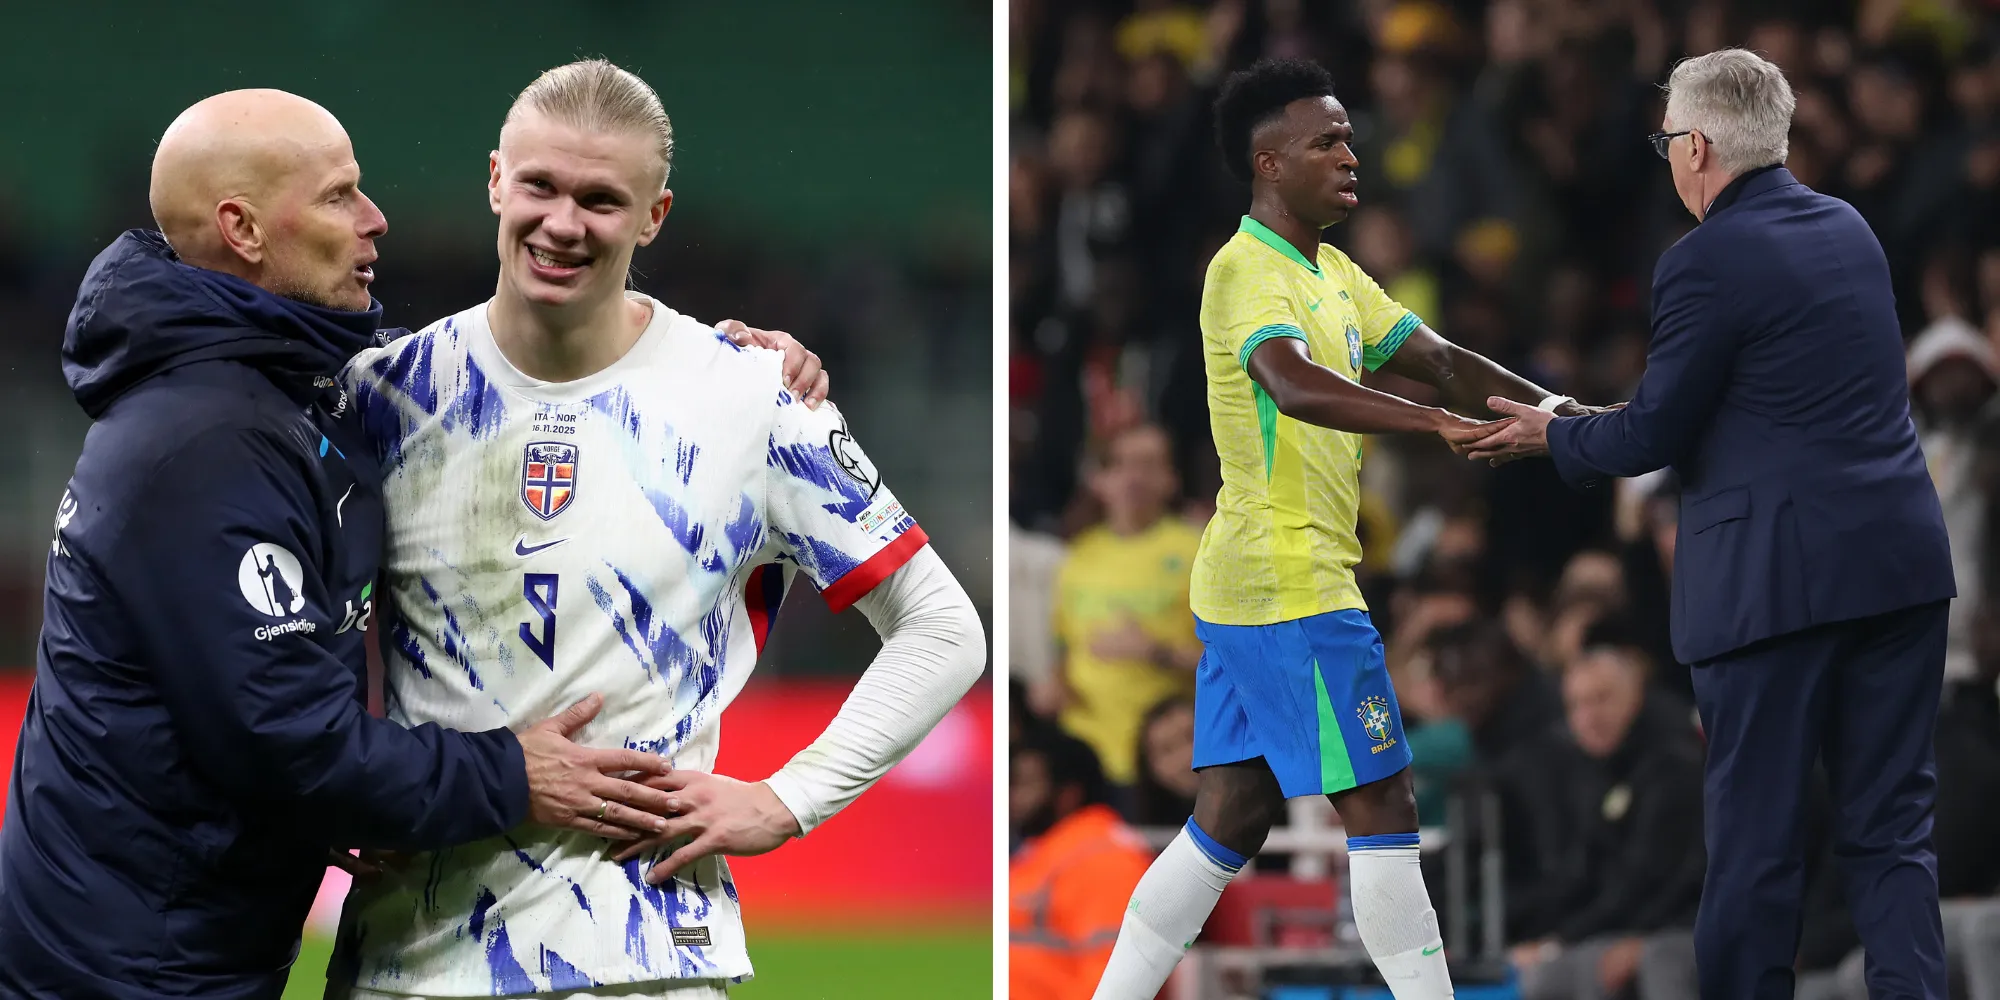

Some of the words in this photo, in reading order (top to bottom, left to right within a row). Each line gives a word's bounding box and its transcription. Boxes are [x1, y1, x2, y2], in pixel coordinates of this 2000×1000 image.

[534, 412, 548, 421] ITA
[556, 413, 577, 422] NOR
[542, 445, 561, 453] NORGE
[864, 501, 899, 532] FOUNDATIO
[254, 618, 316, 641] Gjensidige
[519, 572, 559, 672] 9
[1370, 737, 1397, 755] BRASIL
